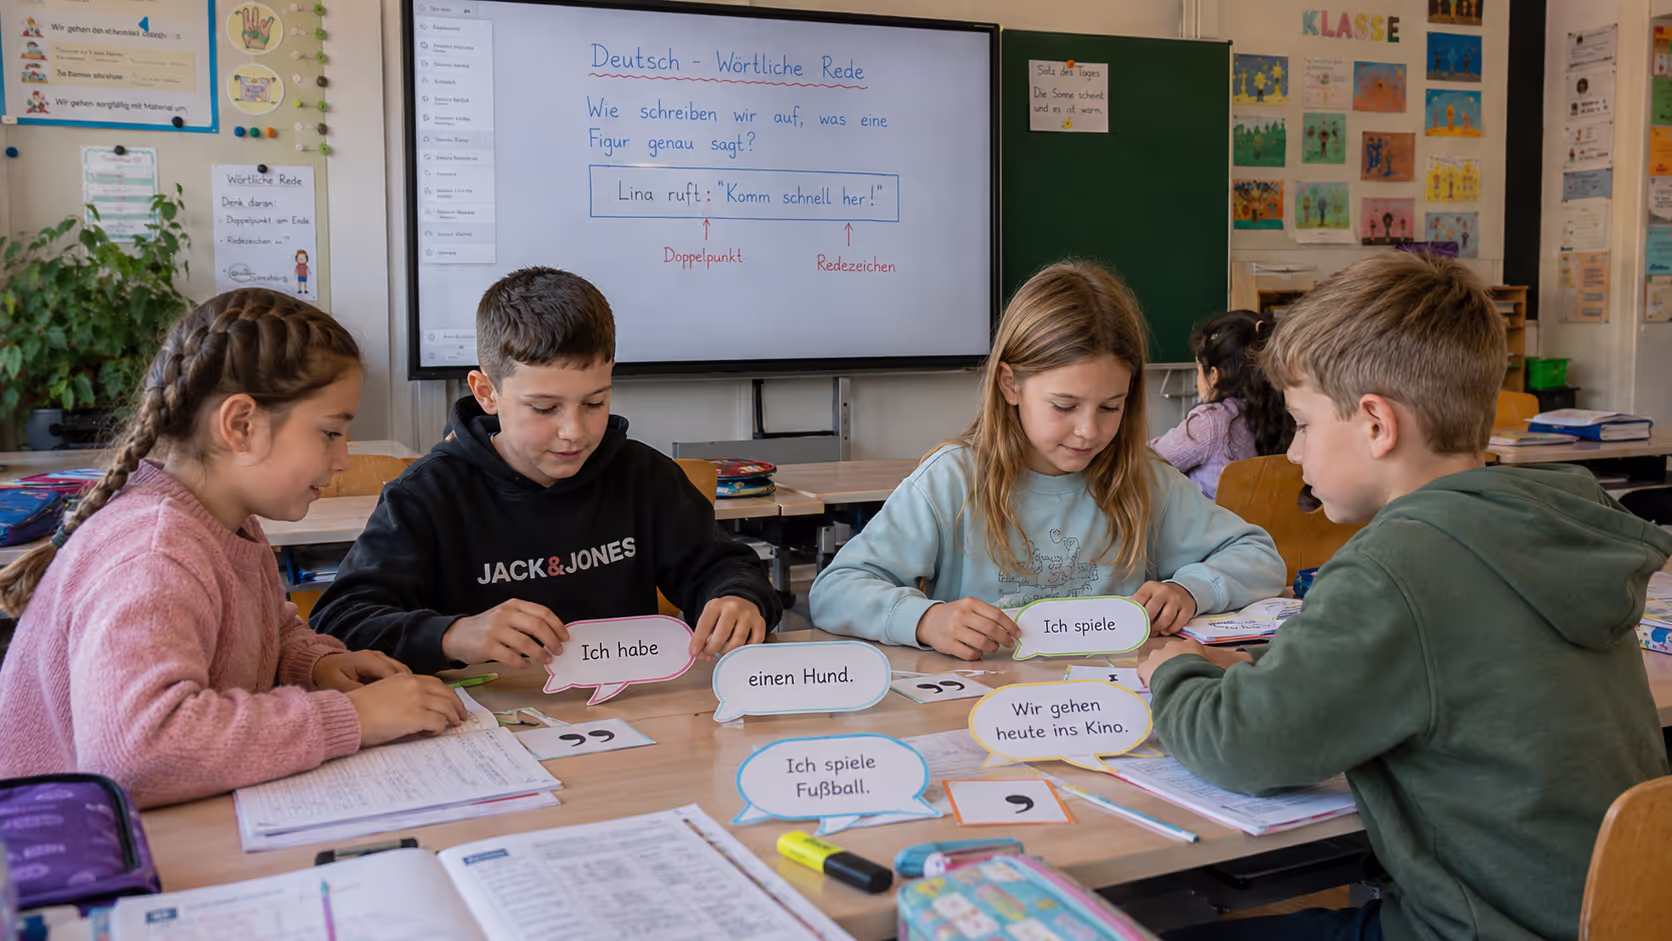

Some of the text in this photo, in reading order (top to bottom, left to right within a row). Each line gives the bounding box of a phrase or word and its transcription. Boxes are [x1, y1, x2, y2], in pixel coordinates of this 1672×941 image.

[1302, 9, 1400, 43] KLASSE
[591, 43, 680, 70] Deutsch
[716, 50, 803, 76] Wörtliche
[821, 55, 865, 80] Rede
[1060, 64, 1073, 76] des
[1076, 65, 1100, 81] Tages
[1033, 86, 1047, 98] Die
[587, 96, 888, 128] Wie schreiben wir auf, was eine
[1033, 103, 1048, 113] und
[588, 128, 756, 159] Figur genau sagt?
[279, 174, 302, 185] Rede
[618, 180, 654, 202] Lina
[782, 185, 831, 206] schnell
[291, 215, 309, 225] Ende
[663, 246, 743, 270] Doppelpunkt
[816, 253, 896, 273] Redezeichen
[1043, 618, 1116, 636] Ich spiele
[581, 640, 659, 662] Ich habe
[748, 667, 854, 687] einen Hund.
[1011, 698, 1101, 719] Wir gehen
[996, 719, 1129, 741] heute ins Kino.
[785, 755, 876, 777] Ich spiele
[796, 780, 871, 800] Fußball.
